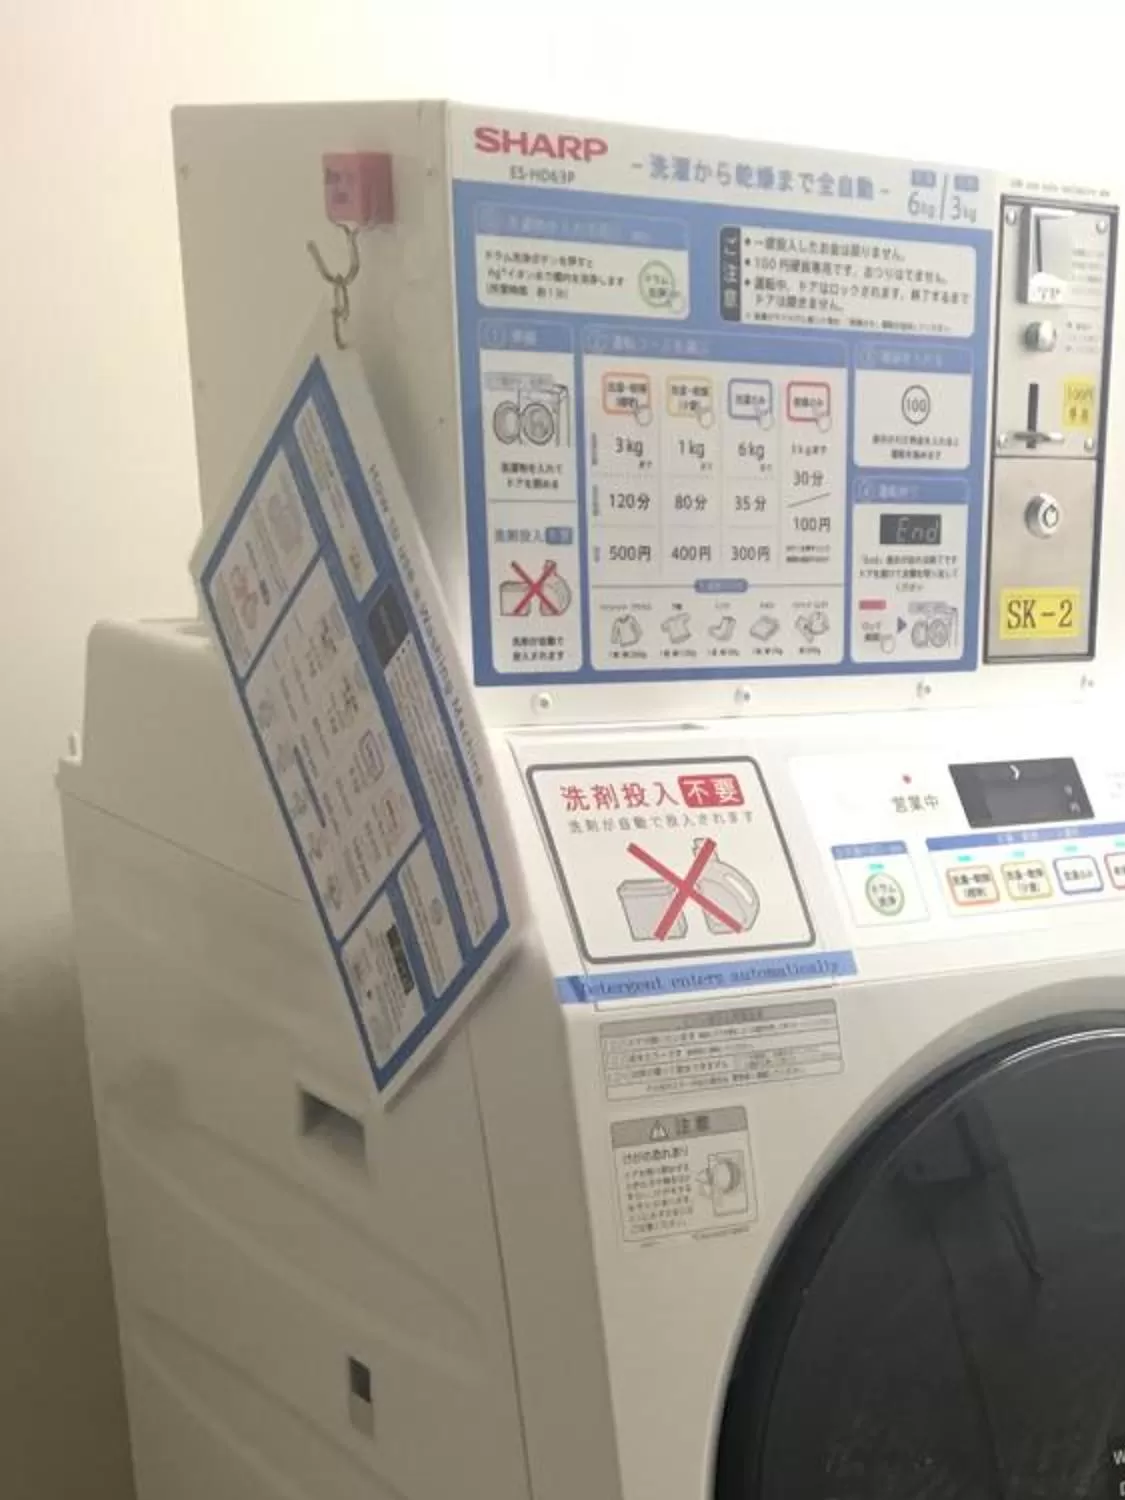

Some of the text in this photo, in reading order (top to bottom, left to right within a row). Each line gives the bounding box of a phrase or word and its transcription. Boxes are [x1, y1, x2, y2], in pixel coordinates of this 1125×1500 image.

[474, 126, 608, 163] SHARP
[609, 493, 650, 514] 120分
[674, 494, 707, 513] 80分
[735, 495, 767, 513] 35分
[793, 516, 831, 533] 100円
[609, 545, 651, 563] 500円
[671, 545, 712, 563] 400円
[731, 545, 771, 563] 300円
[1007, 598, 1073, 630] SK-2
[560, 778, 743, 812] 洗剤投入 不要
[670, 972, 723, 990] enters
[731, 959, 840, 985] automatically
